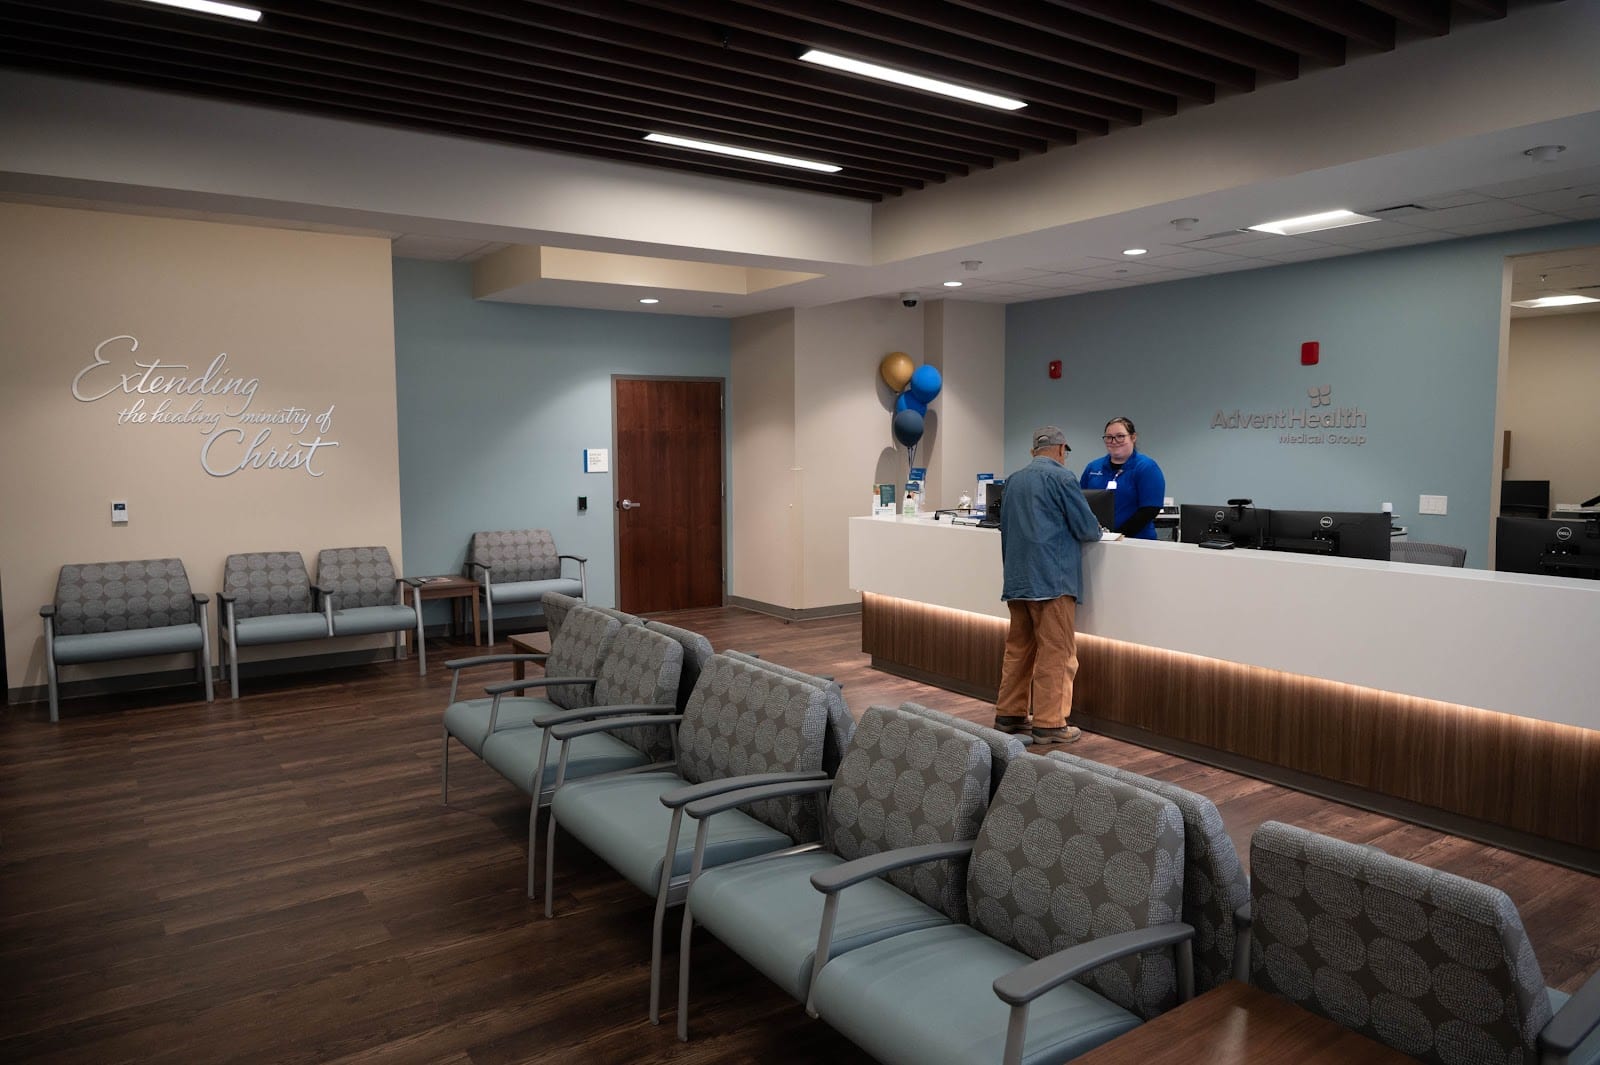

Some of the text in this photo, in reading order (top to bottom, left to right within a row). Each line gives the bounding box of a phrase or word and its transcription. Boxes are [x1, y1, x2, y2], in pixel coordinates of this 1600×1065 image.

[71, 335, 260, 415] Extending
[118, 399, 335, 435] the healing ministry of
[1210, 407, 1367, 429] AdventHealth
[200, 427, 339, 477] Christ
[1279, 433, 1367, 446] Medical Group
